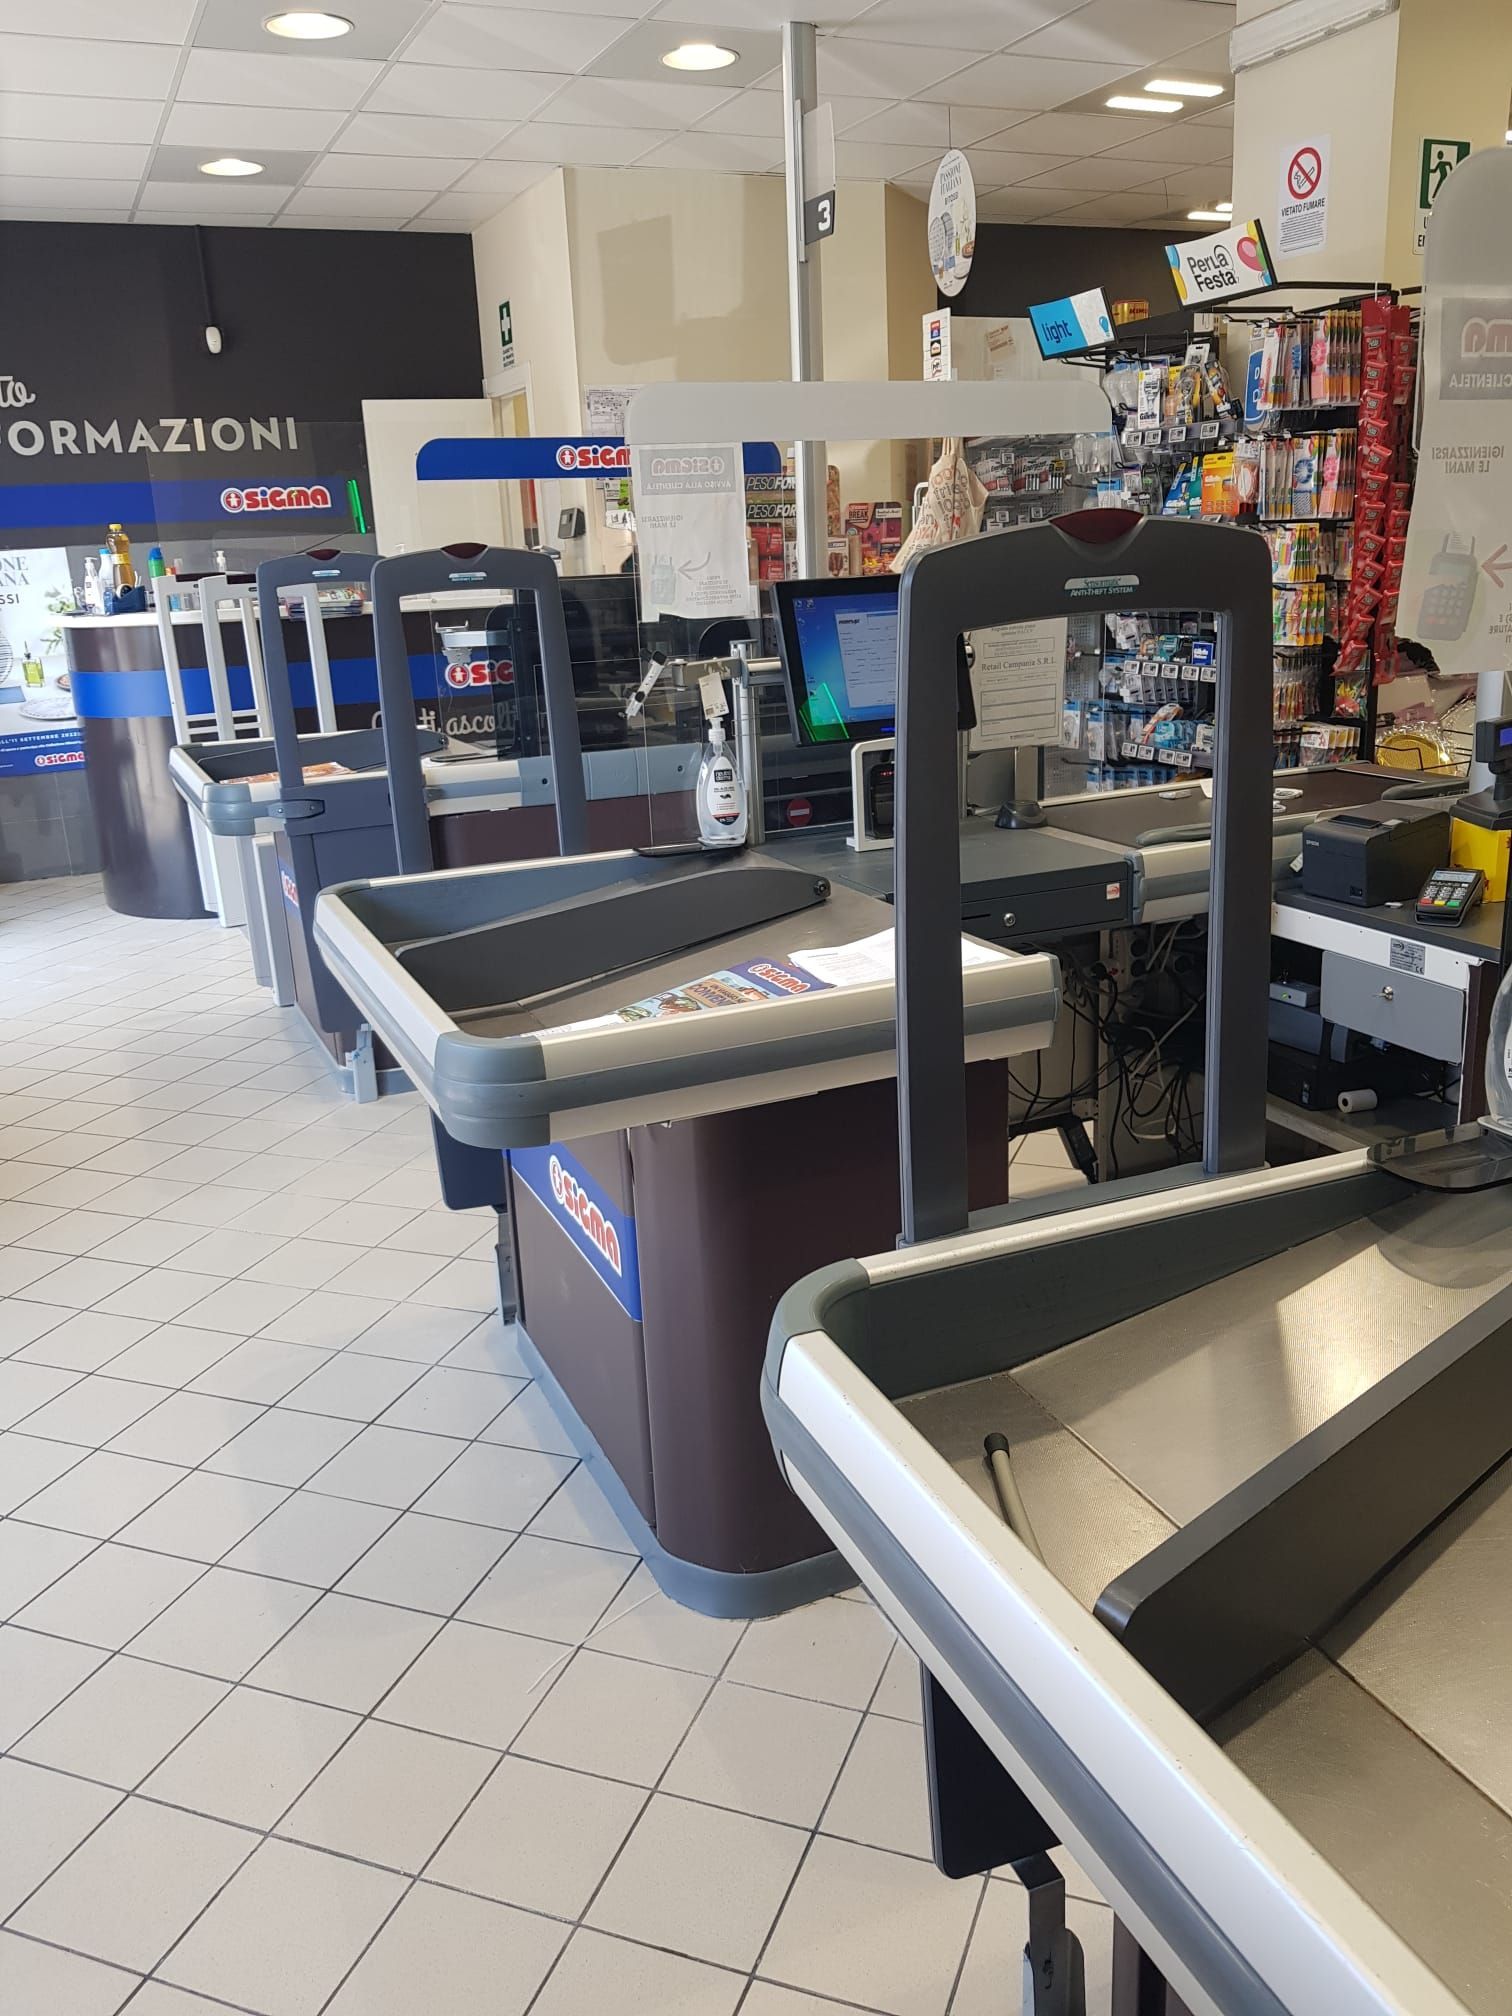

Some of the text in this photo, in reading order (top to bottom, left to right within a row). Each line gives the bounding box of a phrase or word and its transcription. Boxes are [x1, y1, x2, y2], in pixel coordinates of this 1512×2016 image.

[817, 199, 831, 231] 3
[1281, 197, 1326, 217] VIETATO FUMARE
[1194, 270, 1238, 292] Festa
[1041, 320, 1073, 344] light
[0, 416, 298, 457] ORMAZIONI
